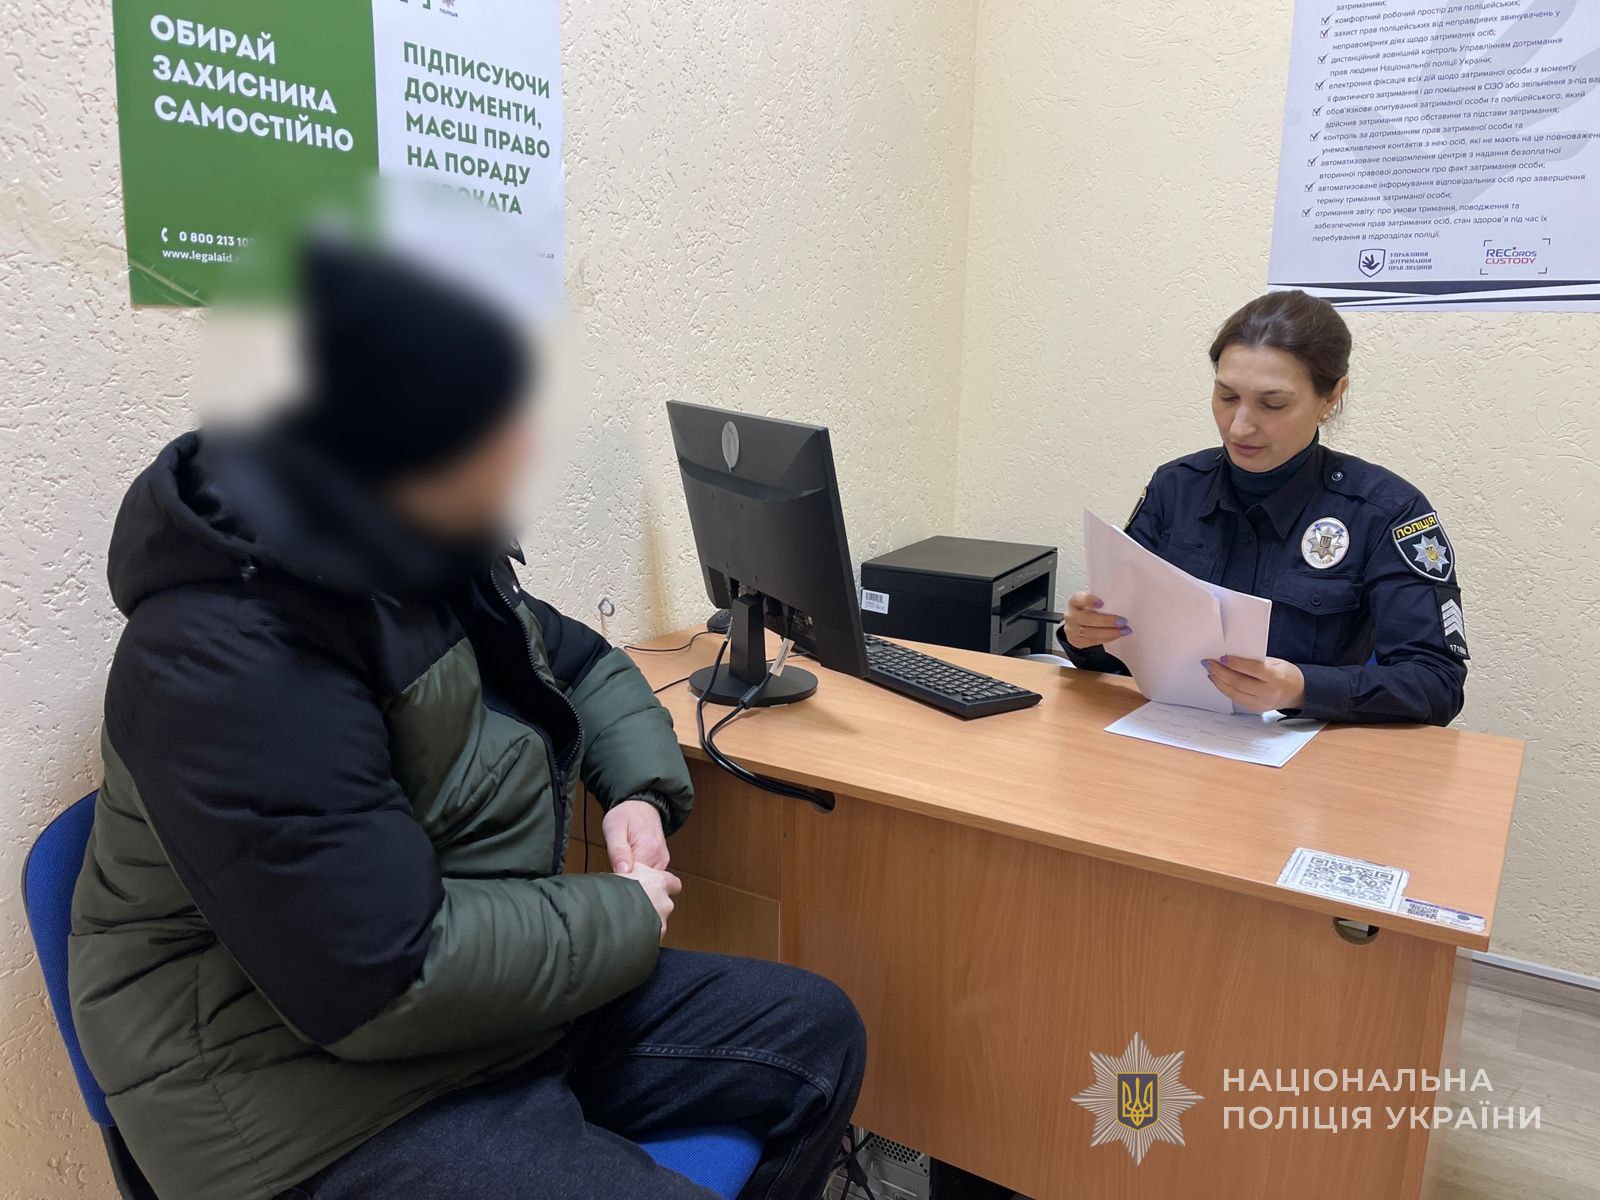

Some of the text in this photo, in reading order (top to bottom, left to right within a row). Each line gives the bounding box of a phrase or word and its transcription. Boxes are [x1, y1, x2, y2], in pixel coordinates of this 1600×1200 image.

[1335, 1, 1521, 25] комфортний робочий простір для поліцейських;
[1336, 1, 1387, 11] затриманими;
[1334, 29, 1358, 38] захист
[1359, 27, 1378, 36] прав
[1379, 22, 1430, 33] поліцейських
[1432, 20, 1444, 28] від
[1446, 17, 1498, 27] неправдивих
[1500, 12, 1554, 22] звинувачень
[150, 15, 276, 65] ОБИРАЙ
[1331, 38, 1563, 64] дистанційний зовнішній контроль Управлінням дотримання
[1332, 29, 1496, 51] неправомірних діях щодо затриманих осіб;
[403, 42, 550, 99] ПІДПИСУЮЧИ
[1328, 80, 1372, 90] електронна
[1373, 77, 1406, 87] фіксація
[1407, 75, 1422, 83] всіх
[1423, 73, 1436, 82] дій
[1437, 73, 1459, 81] щодо
[1461, 69, 1506, 79] затриманої
[1507, 67, 1532, 75] особи
[1540, 64, 1577, 73] моменту
[1330, 57, 1492, 77] прав людини Національної поліції України;
[152, 55, 338, 114] ЗАХИСНИКА
[1332, 92, 1375, 103] фактичного
[1376, 89, 1419, 99] затримання
[1435, 84, 1476, 94] поміщення
[1521, 79, 1565, 88] звільнення
[1567, 77, 1587, 85] з-під
[404, 76, 543, 130] ДОКУМЕНТИ,
[1326, 106, 1372, 115] обов'язкове
[1374, 102, 1418, 112] опитування
[1420, 99, 1462, 108] затриманої
[1464, 97, 1489, 105] особи
[1501, 93, 1563, 103] поліцейського,
[154, 95, 354, 153] САМОСТІЙНО
[1325, 120, 1357, 129] здійснив
[1359, 116, 1402, 126] затримання
[1404, 115, 1419, 123] про
[1420, 112, 1461, 121] обставини
[1473, 109, 1507, 118] підстави
[1509, 107, 1559, 116] затримання;
[405, 111, 550, 158] МАЄШ ПРАВО
[1323, 133, 1357, 142] контроль
[1369, 129, 1420, 139] дотриманням
[1422, 127, 1441, 135] прав
[1442, 123, 1487, 133] затриманої
[1488, 122, 1513, 130] особи
[1321, 144, 1386, 155] унеможливлення
[1387, 141, 1423, 149] контактів
[1449, 138, 1467, 146] осіб,
[1321, 157, 1380, 167] автоматизоване
[1382, 153, 1436, 163] повідомлення
[1437, 151, 1467, 160] центрів
[1475, 149, 1509, 158] надання
[1510, 147, 1561, 156] безоплатної
[406, 145, 531, 187] НА ПОРАДУ
[1319, 171, 1356, 179] вторинної
[1357, 168, 1391, 178] правової
[1392, 167, 1430, 175] допомоги
[1448, 164, 1468, 173] факт
[1469, 163, 1517, 172] затримання
[1518, 161, 1546, 169] особи;
[1318, 173, 1586, 192] автоматизоване інформування відповідальних осіб про завершення
[1316, 191, 1453, 205] терміну тримання затриманої особи;
[1315, 209, 1354, 218] отримання
[1355, 207, 1376, 216] звіту:
[1377, 207, 1391, 215] про
[1393, 206, 1417, 214] умови
[1418, 204, 1458, 213] тримання,
[1459, 203, 1509, 211] поводження
[1313, 221, 1366, 230] забезпечення
[1367, 220, 1385, 228] прав
[1387, 219, 1432, 228] затриманих
[1433, 217, 1452, 225] осіб,
[1472, 216, 1509, 224] здоров'я
[1510, 215, 1523, 223] під
[179, 231, 187, 242] 0
[190, 232, 214, 244] 800
[216, 234, 235, 246] 213
[1312, 233, 1361, 243] перебування
[1368, 231, 1412, 241] підрозділах
[1414, 230, 1440, 239] поліції.
[1485, 257, 1537, 265] CUSTODY
[1396, 516, 1436, 539] ПОЛІЦІЯ
